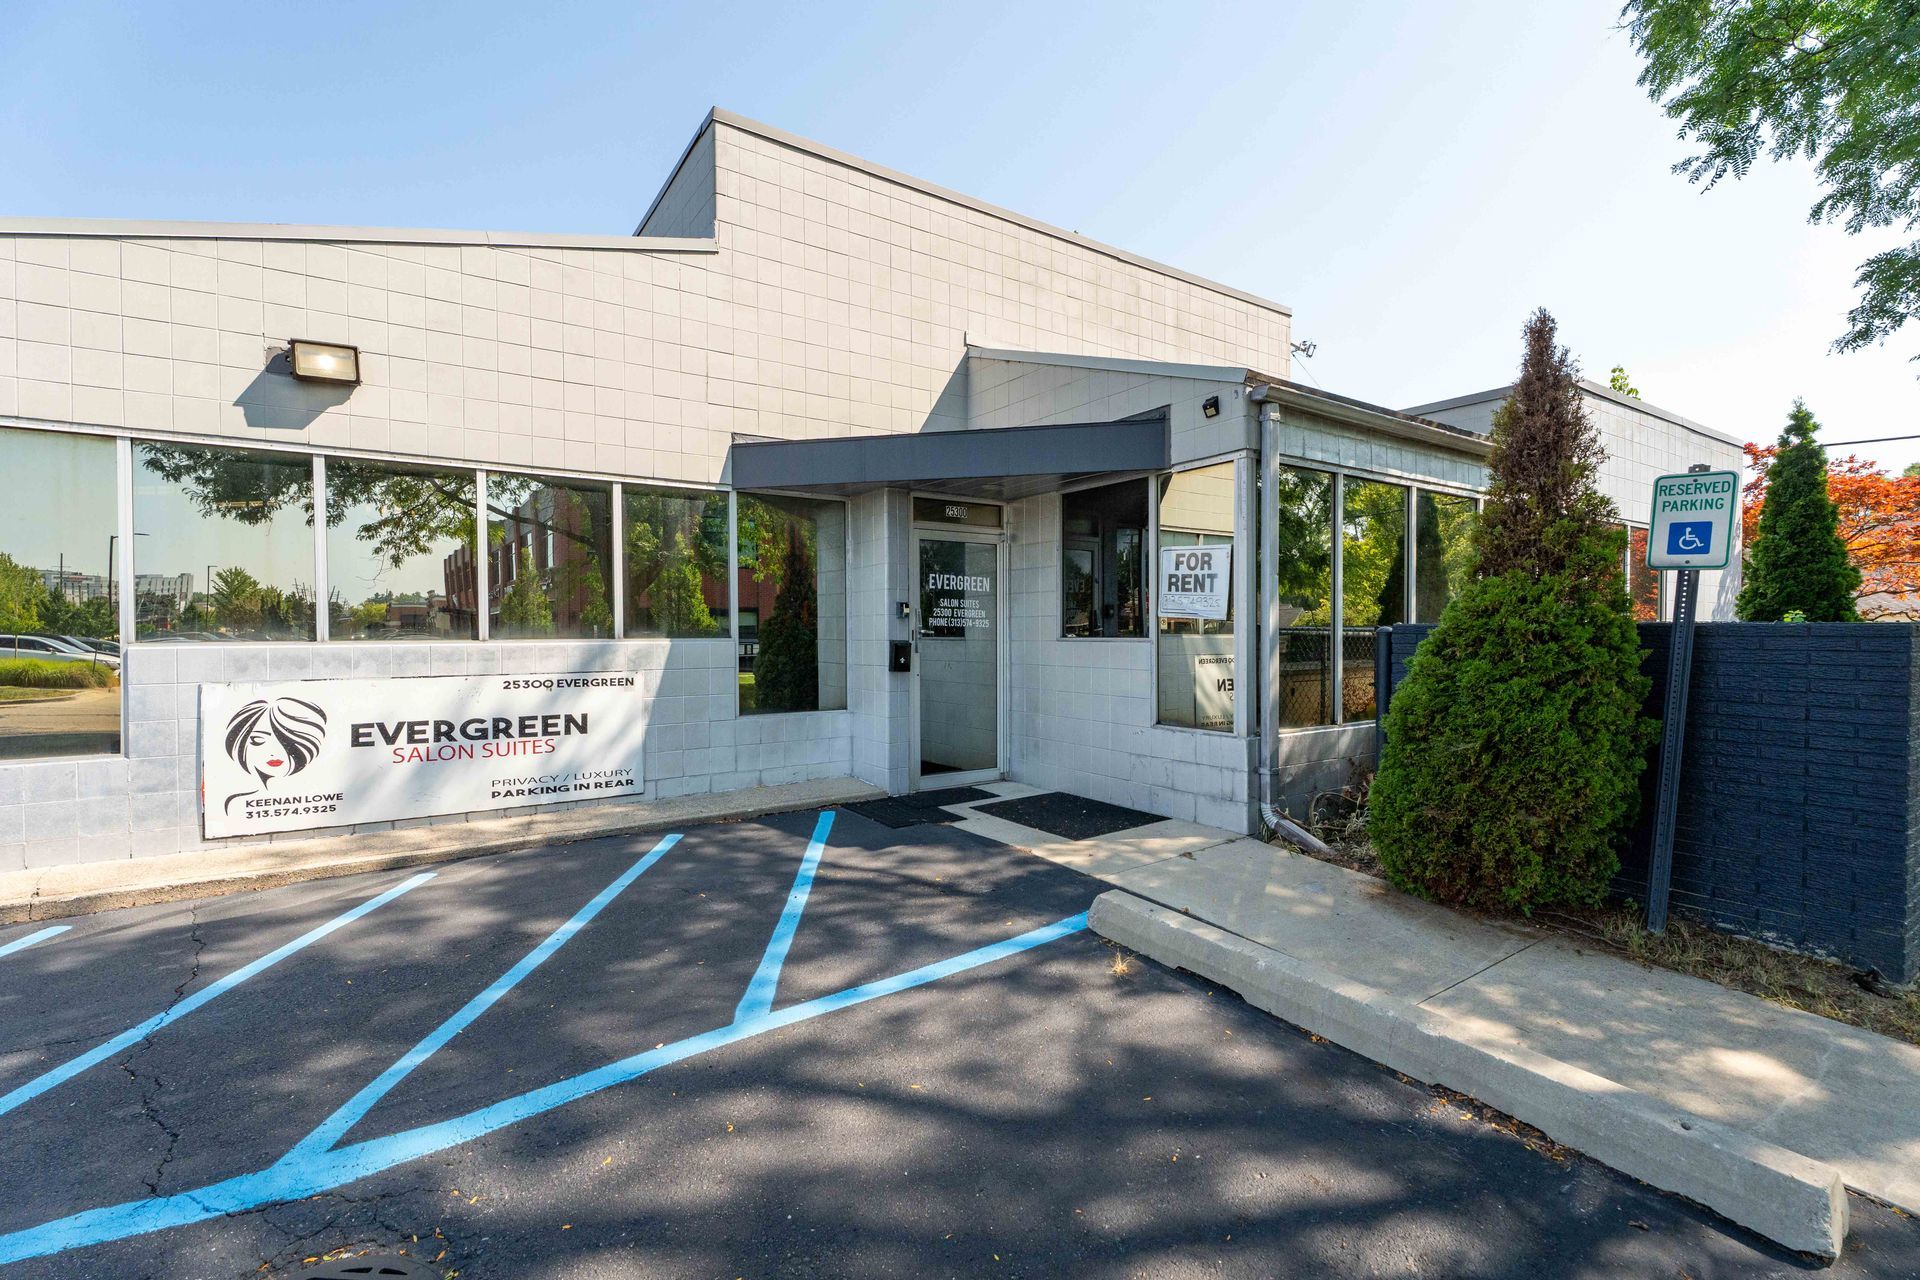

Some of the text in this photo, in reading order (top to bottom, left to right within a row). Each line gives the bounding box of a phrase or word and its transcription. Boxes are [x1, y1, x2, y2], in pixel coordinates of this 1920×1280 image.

[1659, 480, 1731, 496] RESERVED
[945, 506, 968, 518] 25300
[1662, 498, 1724, 512] PARKING
[1175, 552, 1212, 571] FOR
[929, 573, 990, 592] EVERGREEN
[1168, 573, 1218, 593] RENT
[940, 598, 980, 609] SALON SUITES
[933, 608, 986, 618] 25300 EVERGREEN
[503, 677, 634, 690] 25300 EVERGREEN
[351, 712, 588, 748] EVERGREEN
[392, 738, 556, 764] SALON SUITES
[491, 774, 560, 788] PRIVACY
[574, 768, 633, 781] LUXURY
[491, 778, 635, 799] PARKING IN REAR
[245, 792, 344, 808] KEENAN LOWE
[245, 804, 337, 819] 313.574.9325
